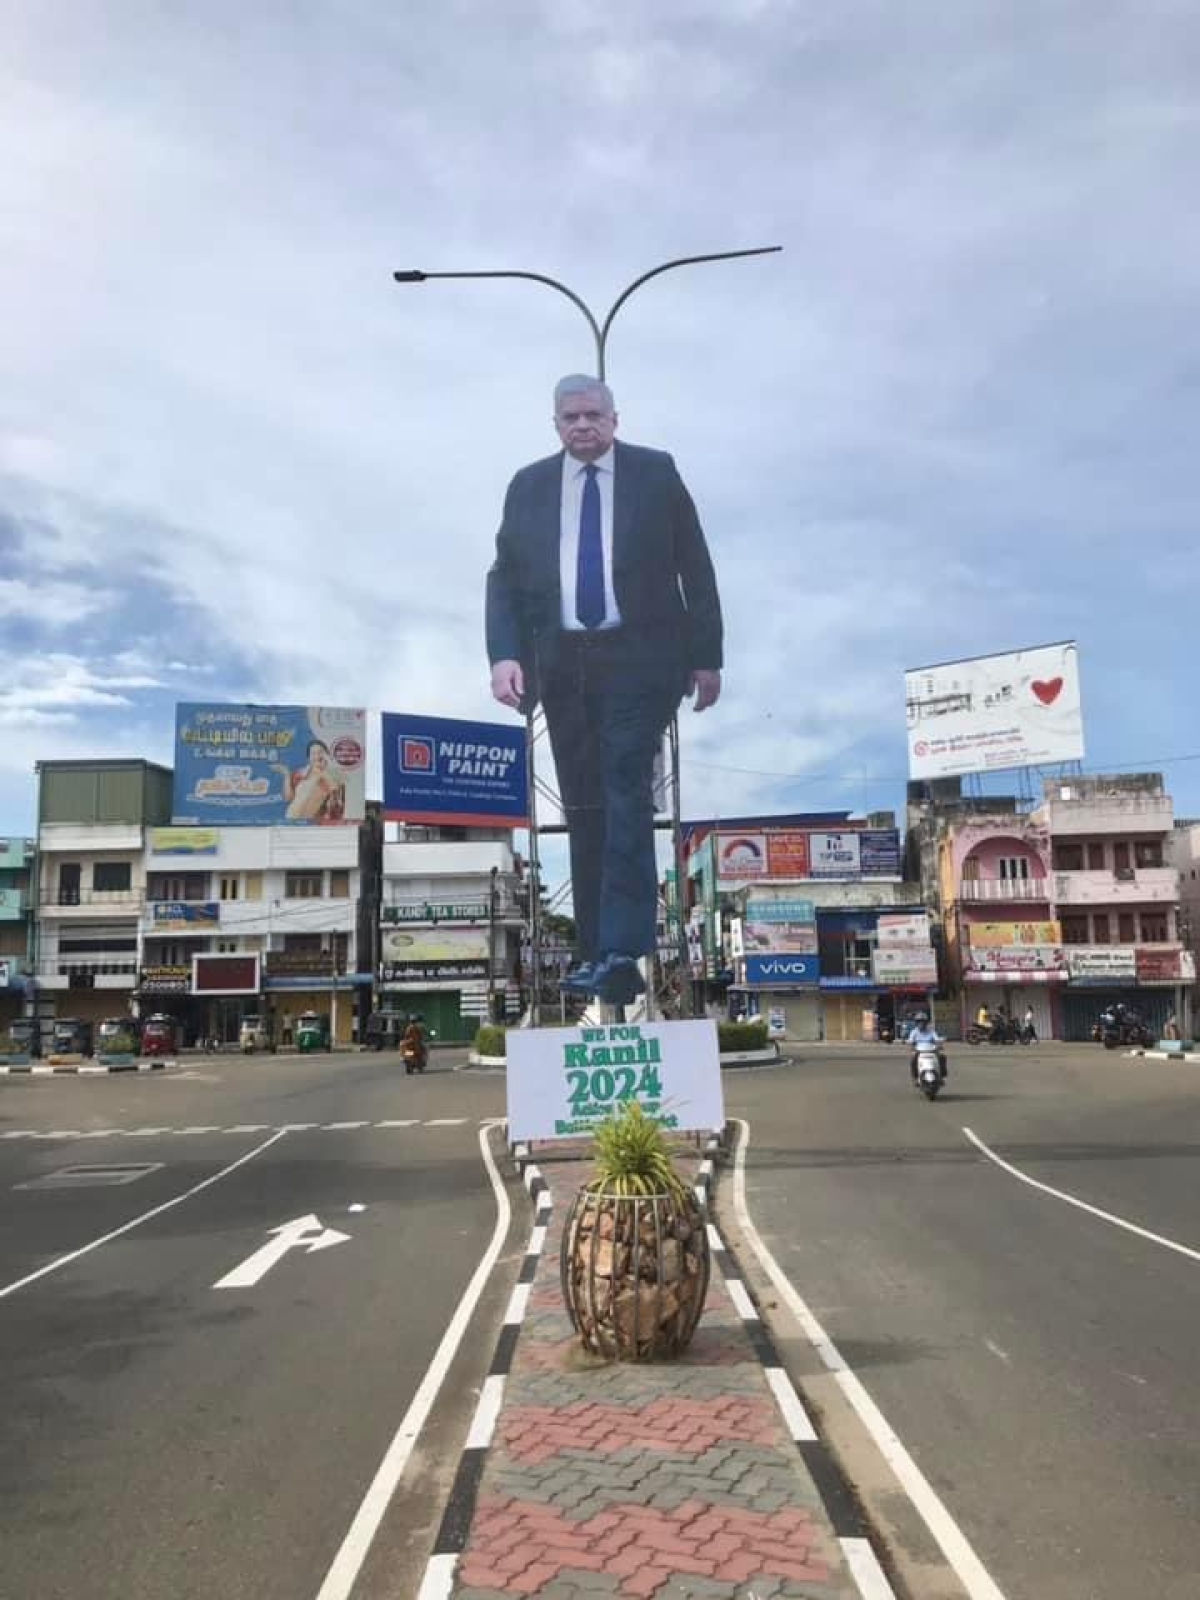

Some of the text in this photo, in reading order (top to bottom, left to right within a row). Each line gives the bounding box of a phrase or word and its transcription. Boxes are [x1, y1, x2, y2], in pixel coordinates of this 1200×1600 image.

[439, 742, 516, 763] NIPPON
[448, 759, 510, 778] PAINT
[759, 960, 806, 974] vivo
[580, 1026, 641, 1042] WE FOR
[563, 1037, 662, 1068] Ranil
[567, 1064, 662, 1102] 2024
